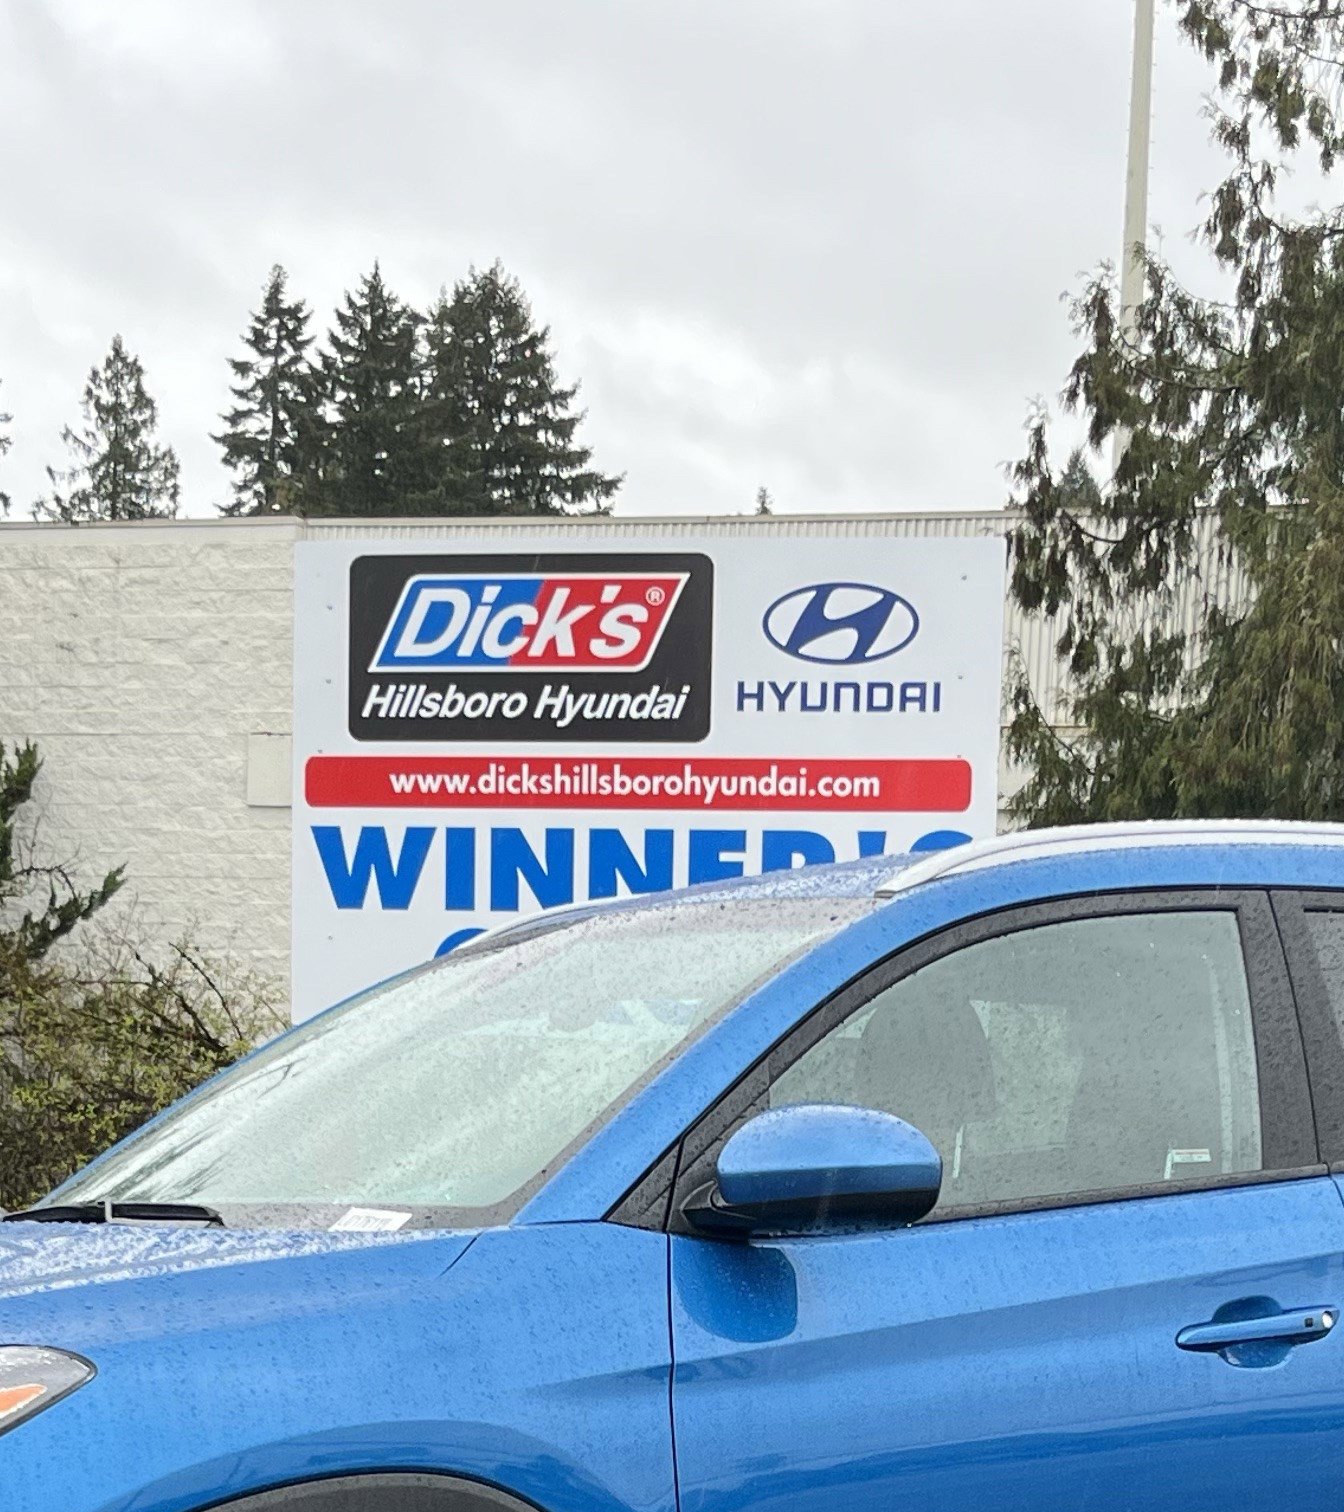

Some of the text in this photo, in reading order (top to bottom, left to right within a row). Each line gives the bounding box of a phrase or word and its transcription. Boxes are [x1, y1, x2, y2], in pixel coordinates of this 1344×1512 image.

[394, 586, 649, 659] Dick's
[362, 684, 690, 727] Hillsboro Hyundai
[737, 681, 941, 712] HYUNDAI
[389, 765, 881, 805] www.dickshillsborohyundai.com
